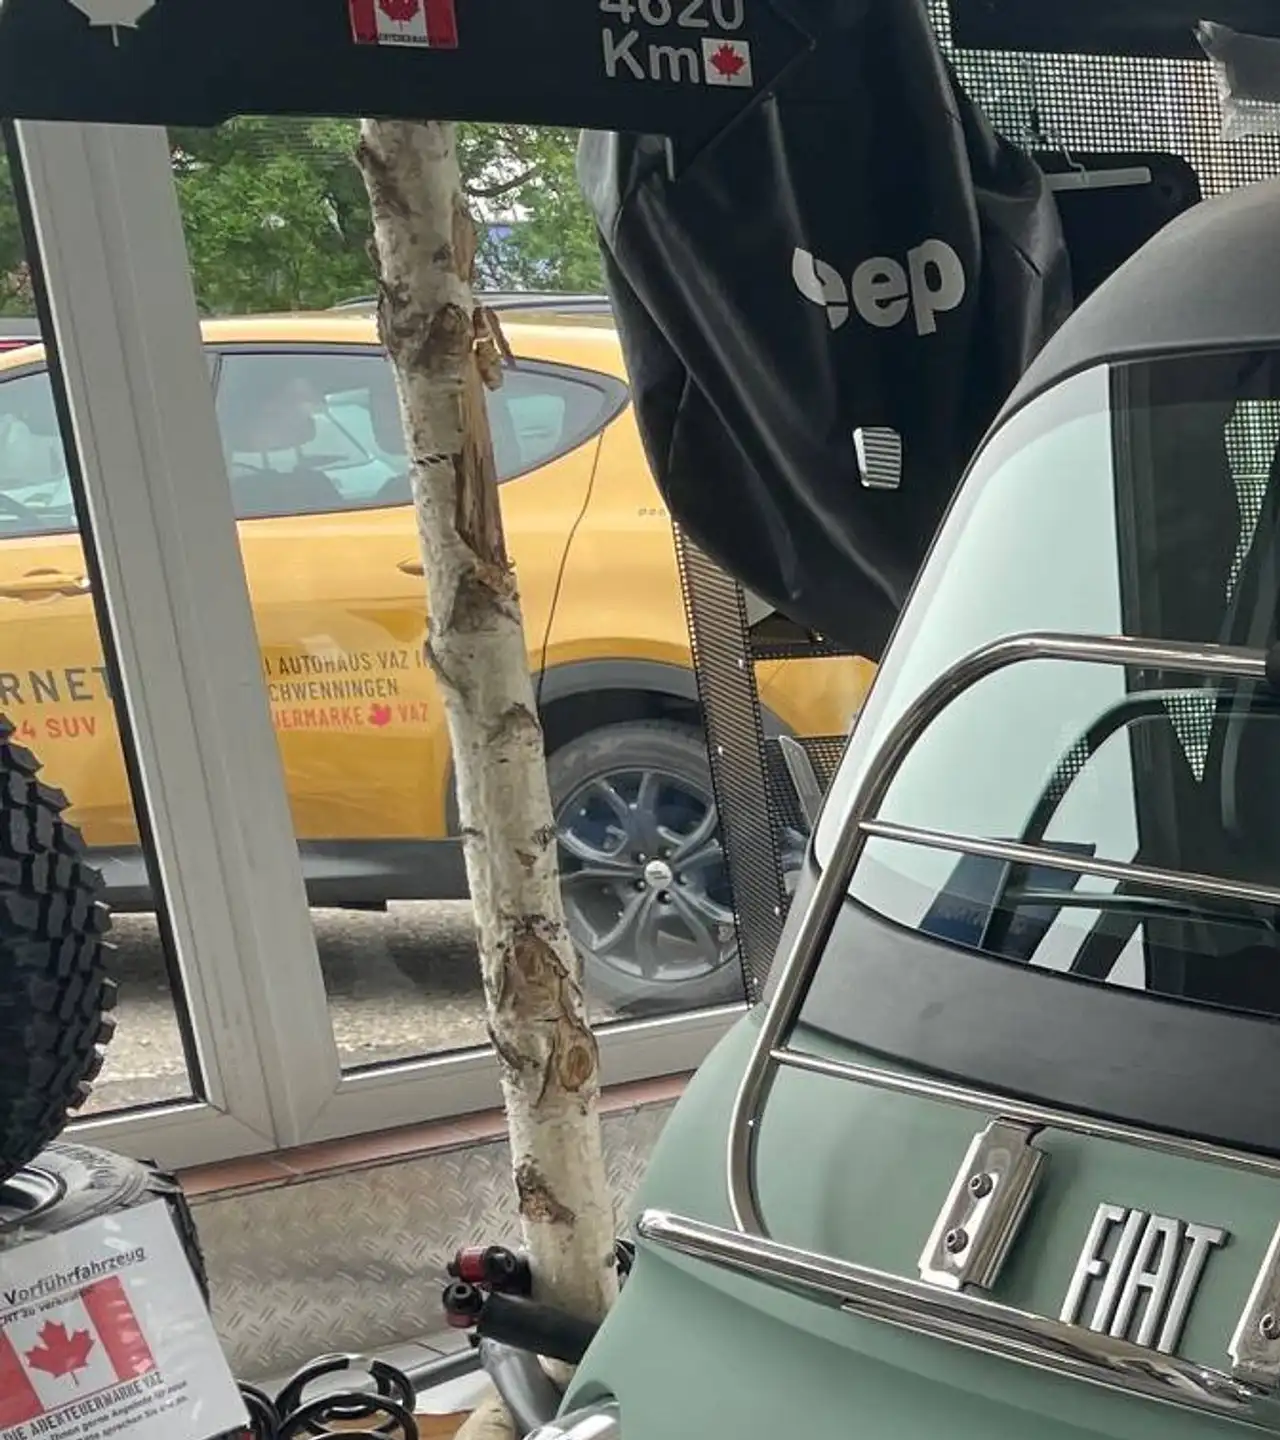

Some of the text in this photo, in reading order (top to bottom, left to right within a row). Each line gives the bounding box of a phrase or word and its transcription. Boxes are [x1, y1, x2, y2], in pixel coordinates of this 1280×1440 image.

[602, 28, 700, 84] Km
[792, 238, 966, 336] eep
[279, 653, 372, 676] AUTOHAUS
[376, 649, 410, 669] VAZ
[268, 678, 399, 702] CHWENNINGEN
[46, 716, 95, 737] SUV
[1060, 1202, 1230, 1355] FIAT
